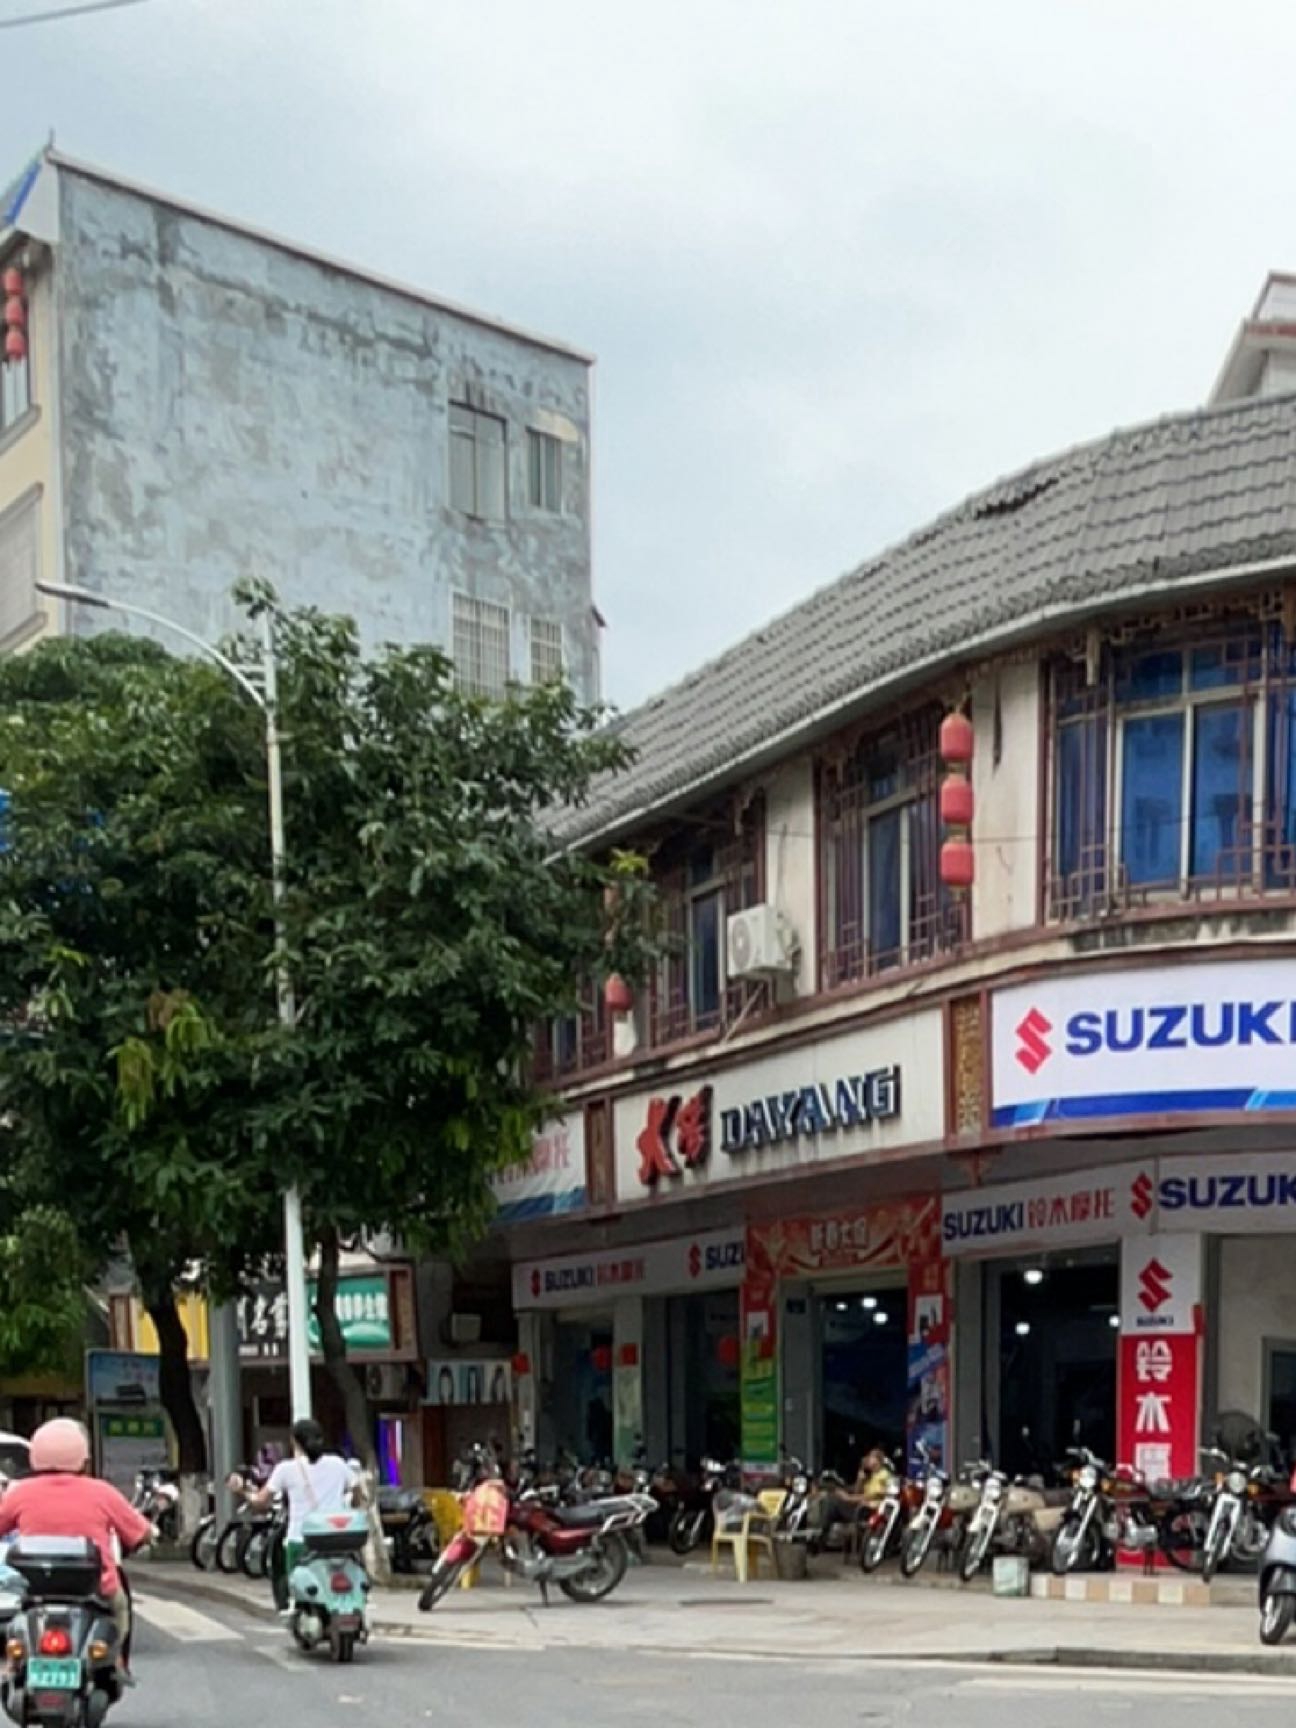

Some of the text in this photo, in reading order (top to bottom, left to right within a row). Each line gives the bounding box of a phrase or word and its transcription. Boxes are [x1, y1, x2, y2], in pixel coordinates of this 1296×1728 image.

[719, 1066, 902, 1155] DAYANG
[944, 1187, 1114, 1241] SUZUKI 铃木摩托
[705, 1241, 744, 1271] SUZ
[545, 1266, 594, 1293] SUZUKI
[1136, 1315, 1174, 1327] SUZUKI
